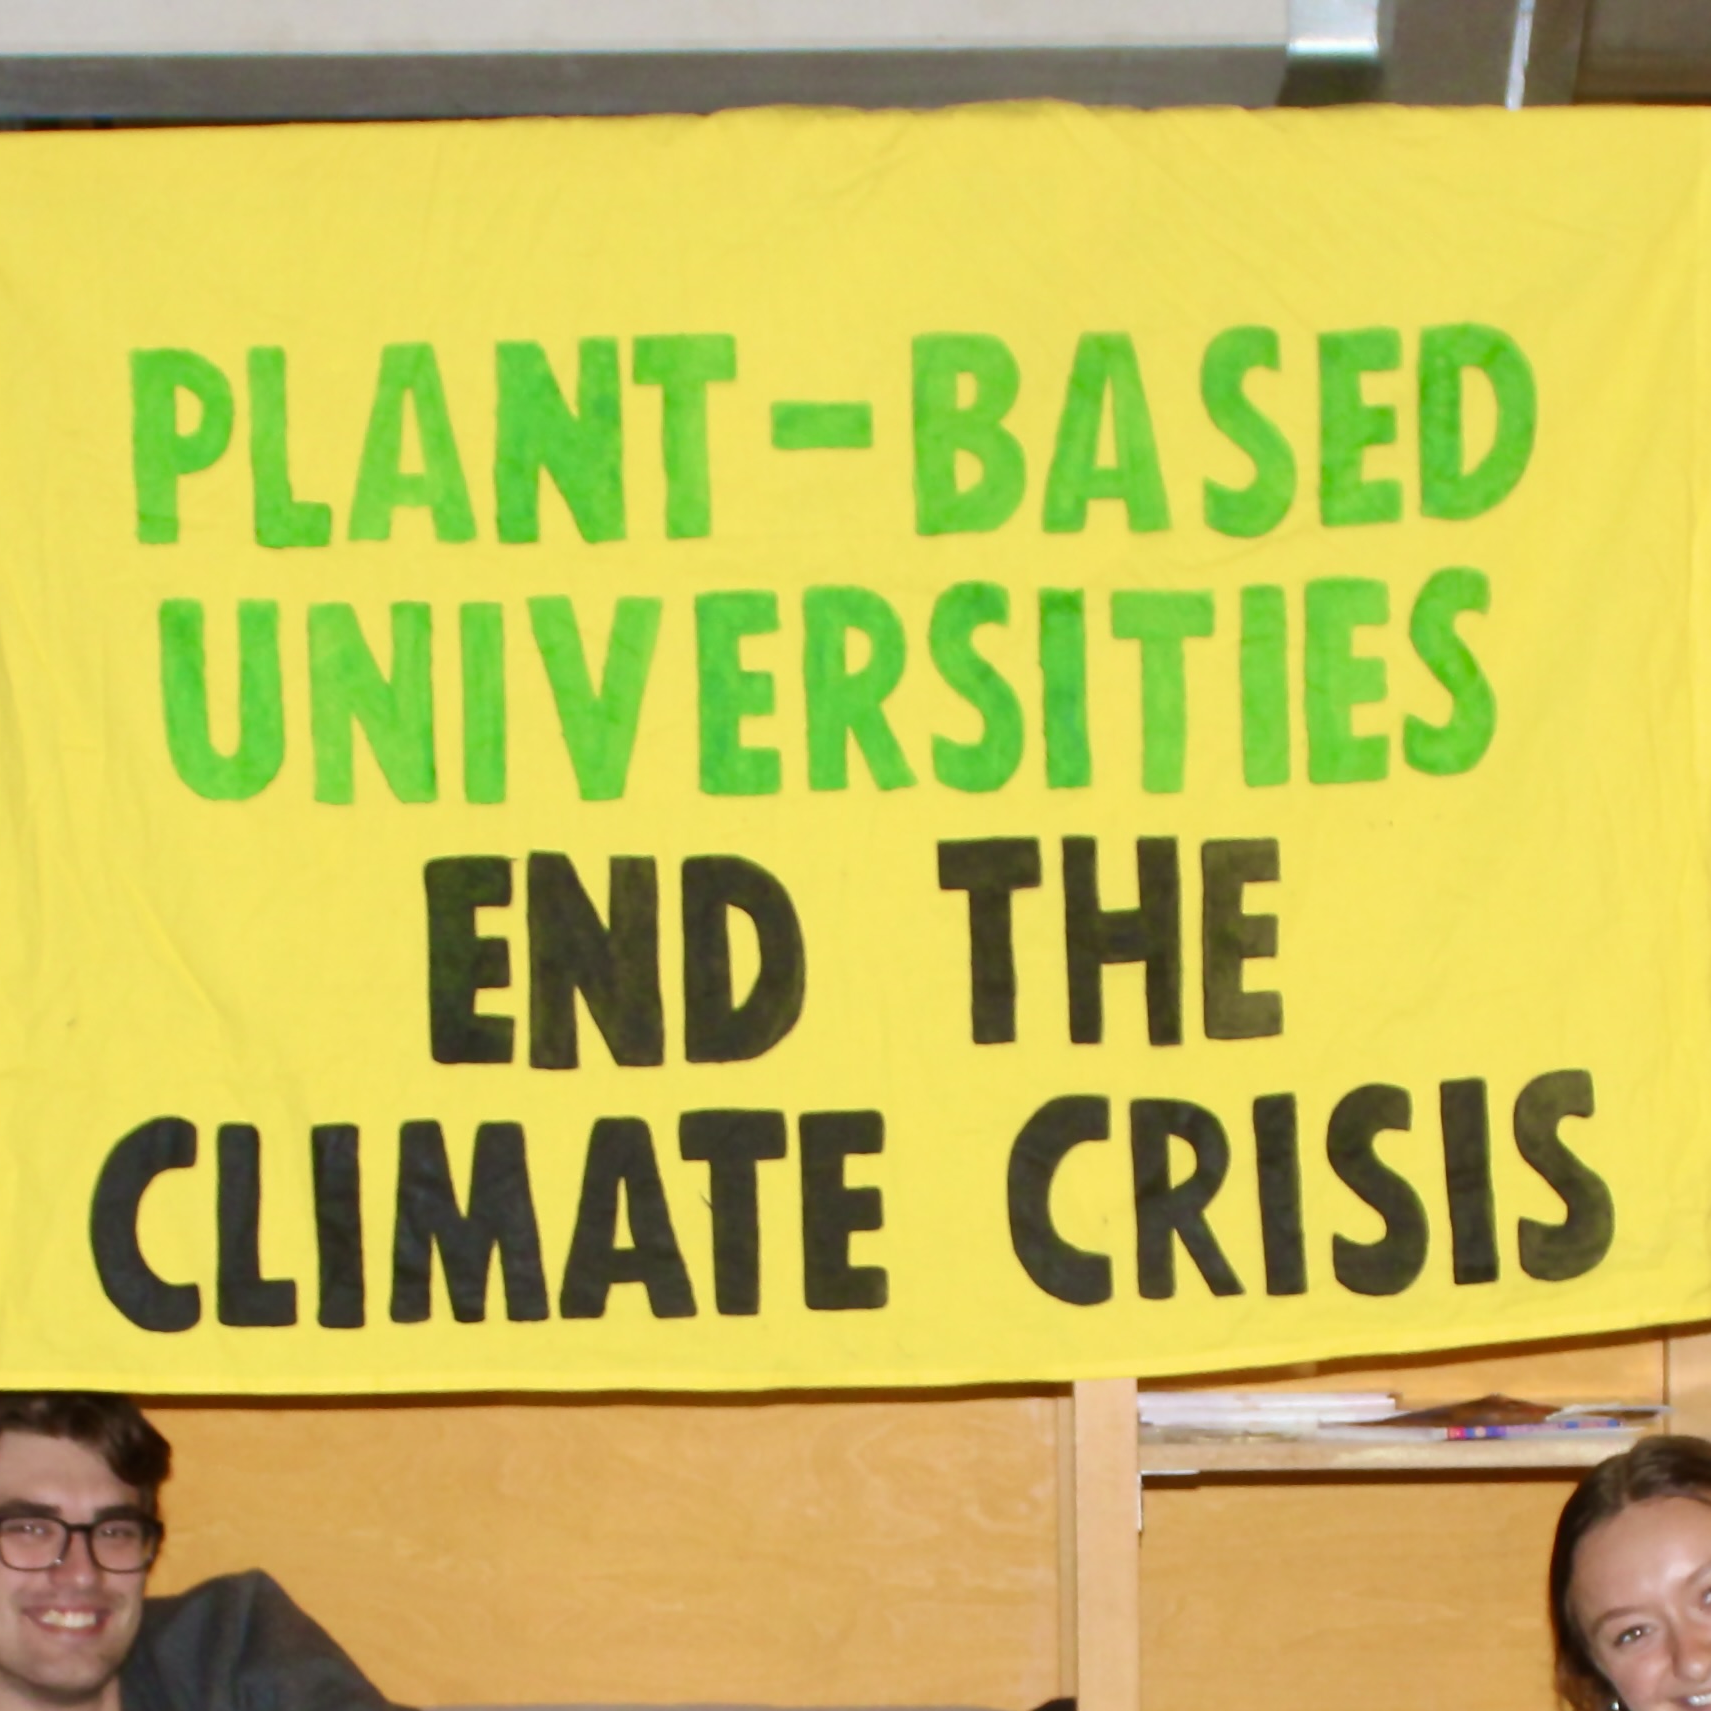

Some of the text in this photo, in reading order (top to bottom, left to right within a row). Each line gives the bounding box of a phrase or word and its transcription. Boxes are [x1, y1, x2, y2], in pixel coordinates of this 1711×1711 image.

[131, 324, 1536, 548] PLANT-BASED
[159, 567, 1495, 803] UNIVERSITIES
[424, 836, 1283, 1069] END THE
[90, 1070, 1613, 1332] CLIMATE CRISIS
